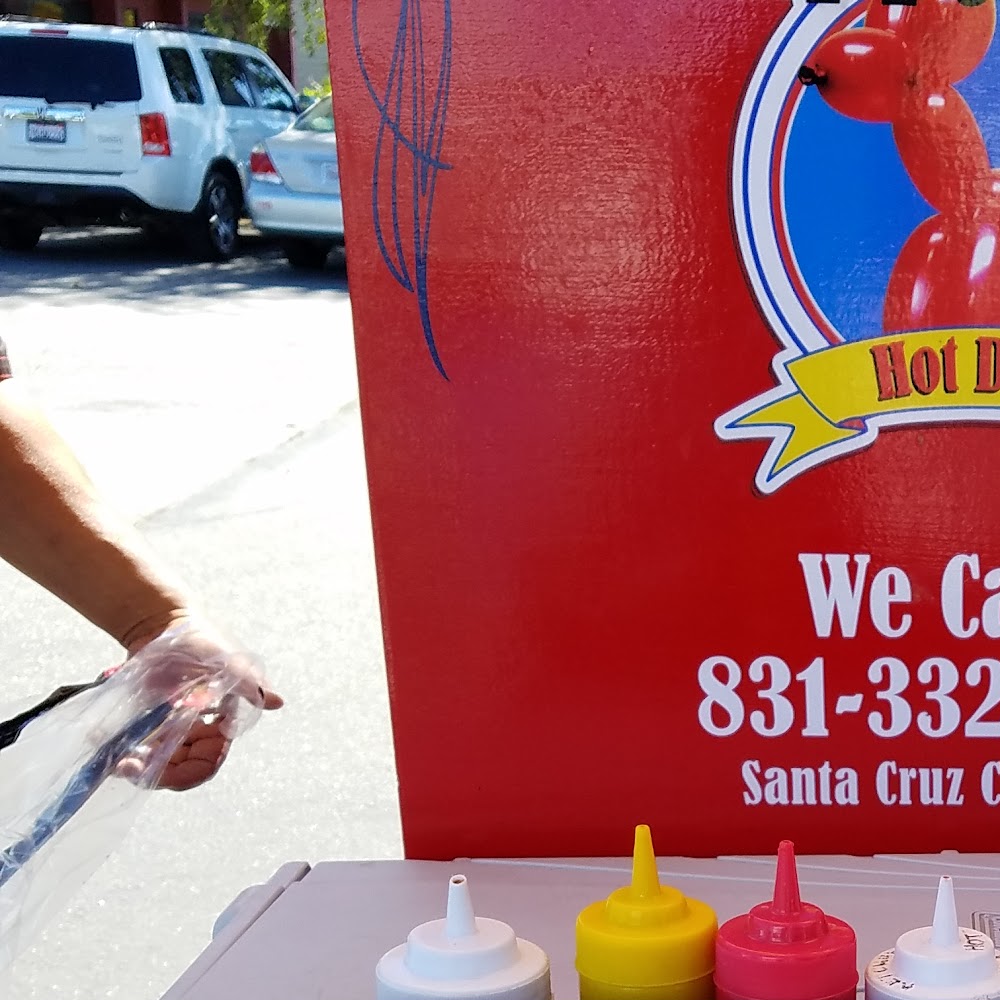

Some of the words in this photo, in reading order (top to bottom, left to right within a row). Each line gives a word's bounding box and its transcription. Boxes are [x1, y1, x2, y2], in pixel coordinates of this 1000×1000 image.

[870, 335, 959, 402] Hot
[799, 553, 912, 638] We
[741, 760, 859, 806] Santa
[876, 760, 965, 806] Cruz
